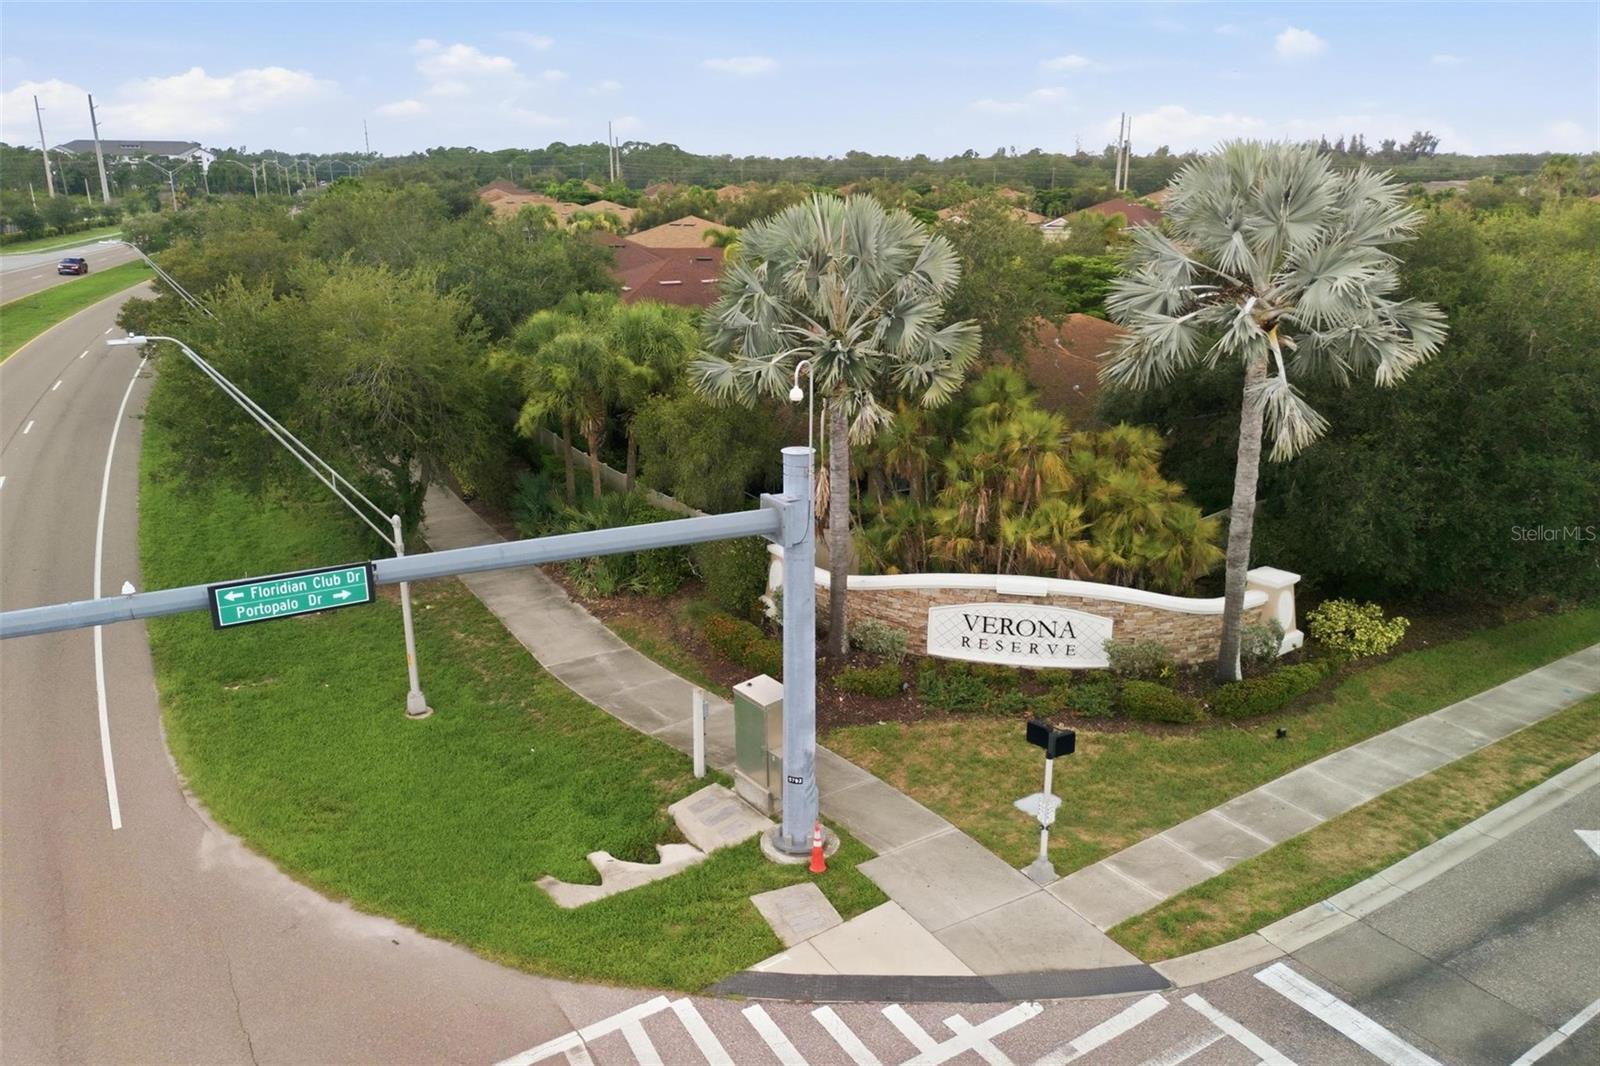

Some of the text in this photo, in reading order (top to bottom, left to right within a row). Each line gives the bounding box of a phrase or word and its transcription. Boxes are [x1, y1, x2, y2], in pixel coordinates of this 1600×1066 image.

[250, 571, 360, 599] Floridian Club Dr
[236, 594, 322, 618] Portopalo Dr
[963, 613, 1077, 639] VERONA
[961, 636, 1076, 656] RESERVE
